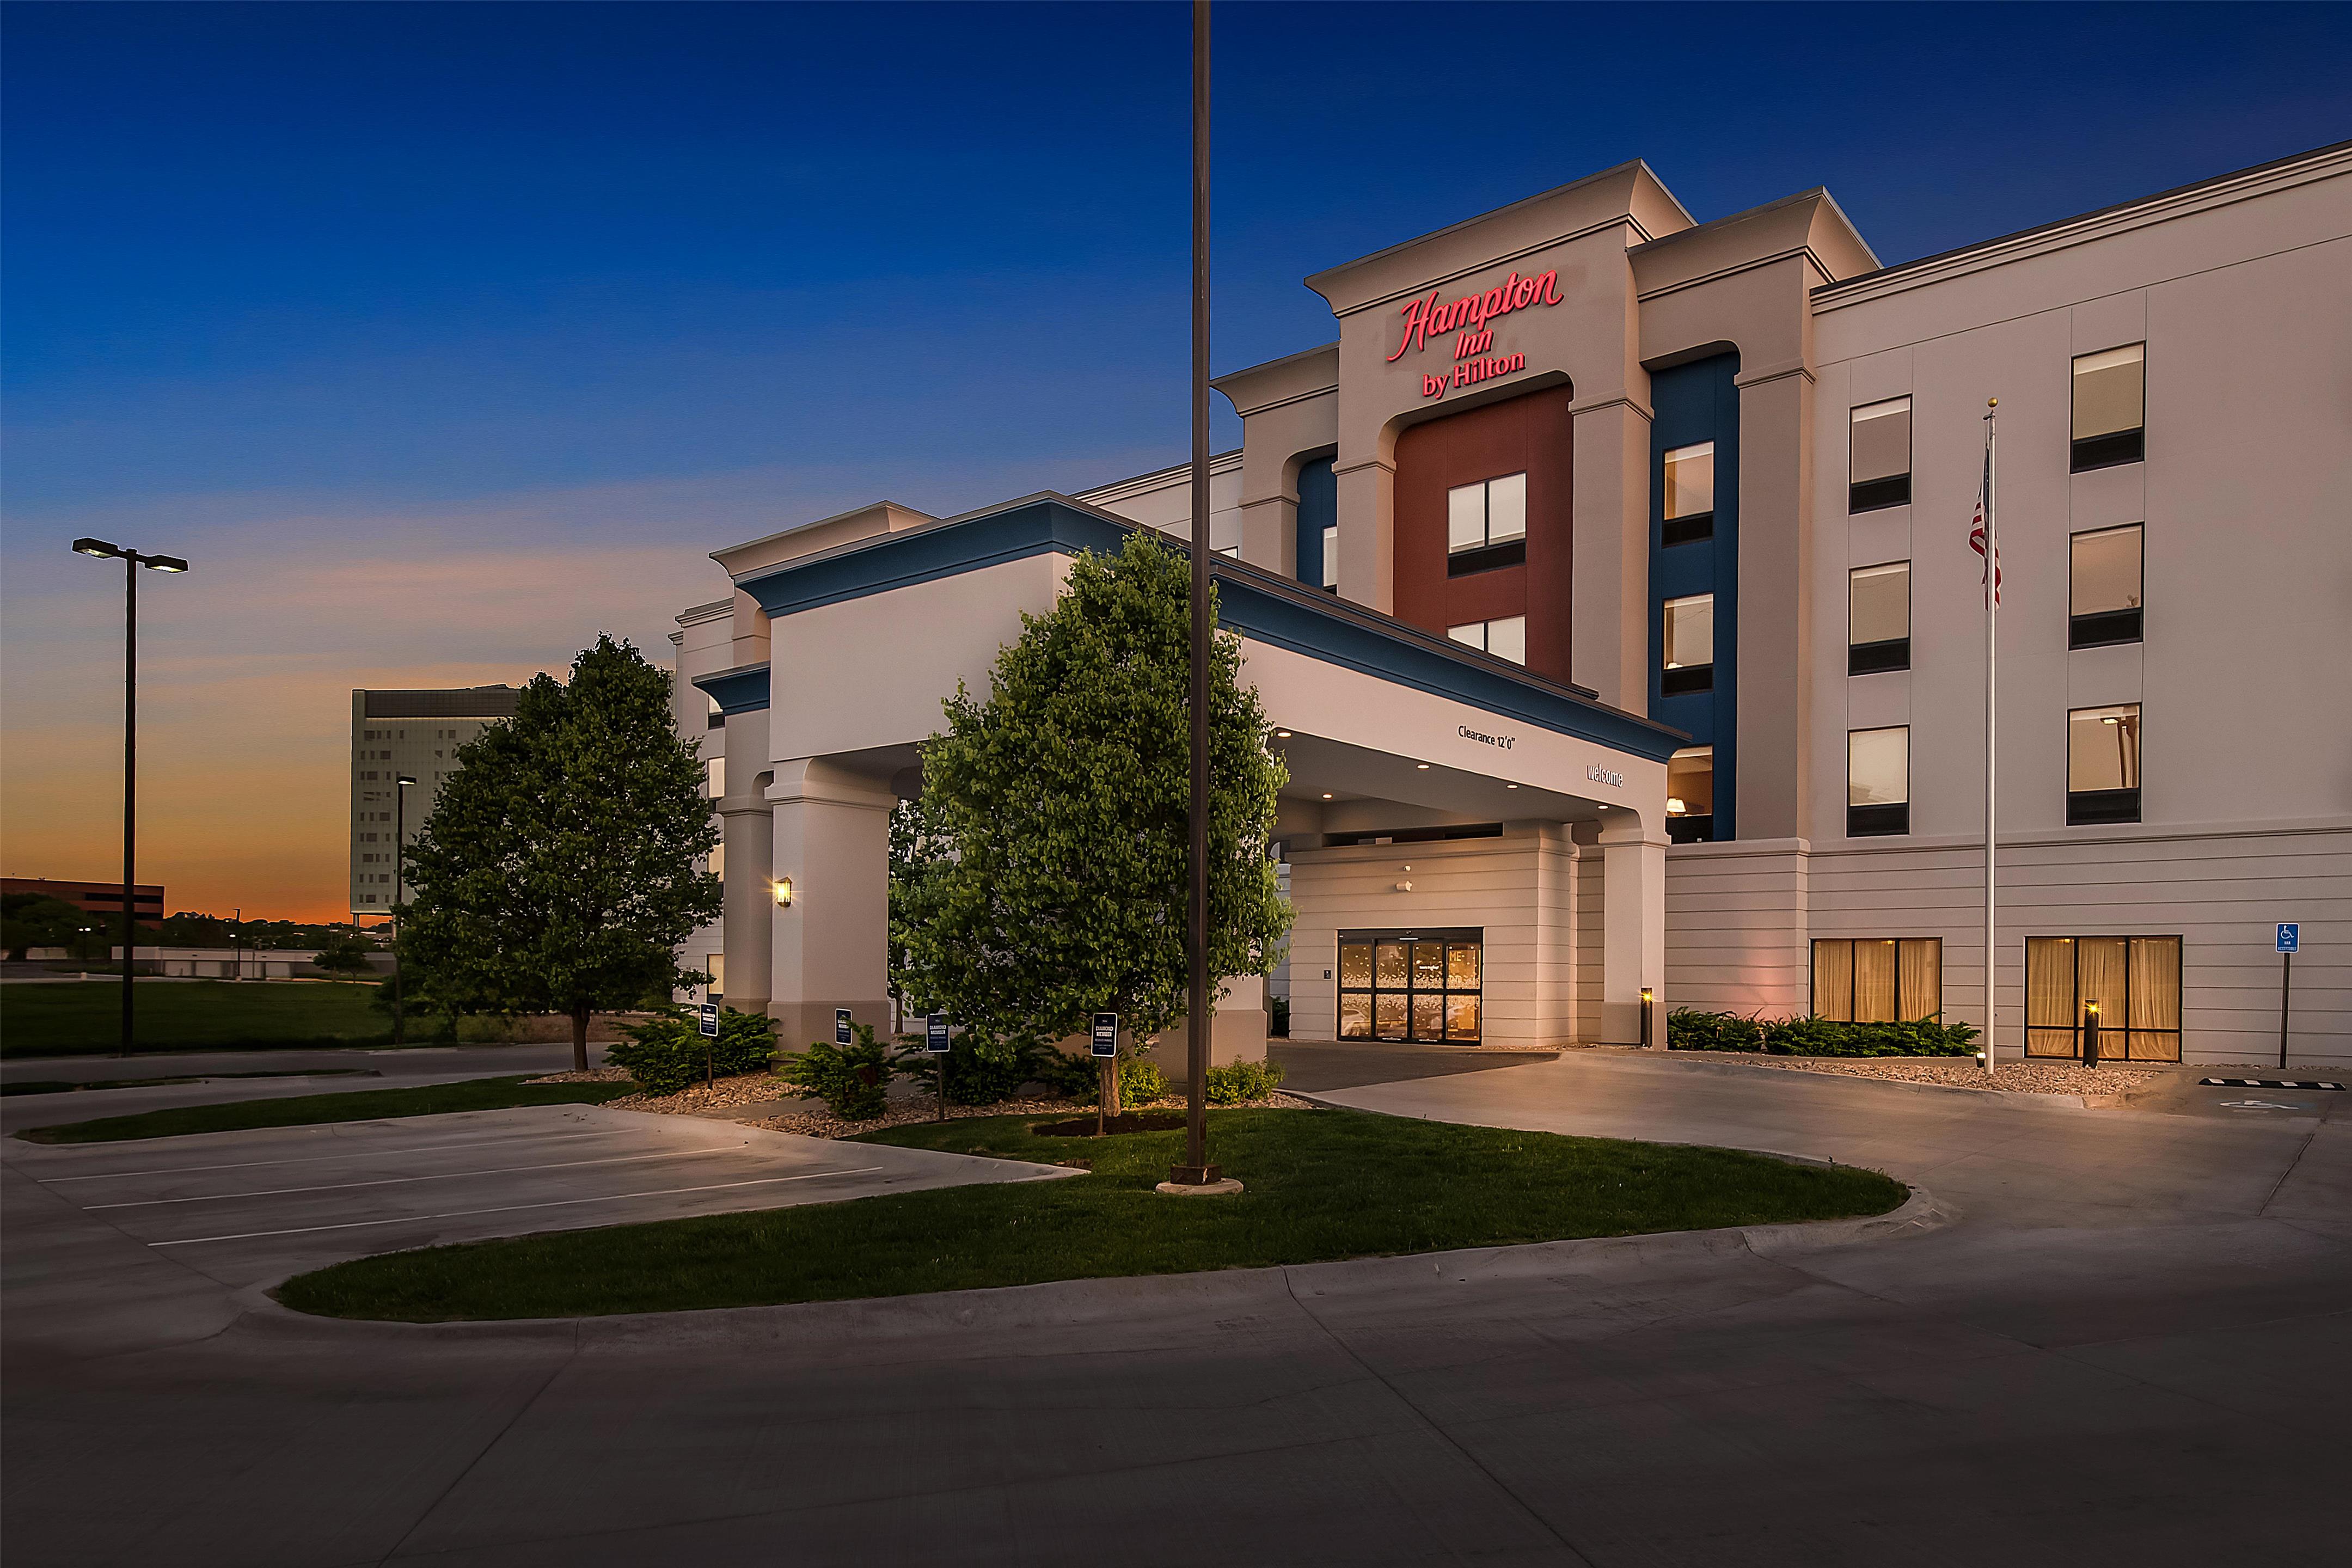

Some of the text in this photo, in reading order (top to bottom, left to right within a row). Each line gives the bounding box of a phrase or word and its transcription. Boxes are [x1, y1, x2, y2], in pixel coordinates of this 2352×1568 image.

[1387, 270, 1564, 362] Hampton
[1455, 329, 1493, 360] Inn
[1423, 352, 1526, 399] by Hilton
[1458, 725, 1495, 746] Clearance
[1587, 764, 1623, 788] welcome
